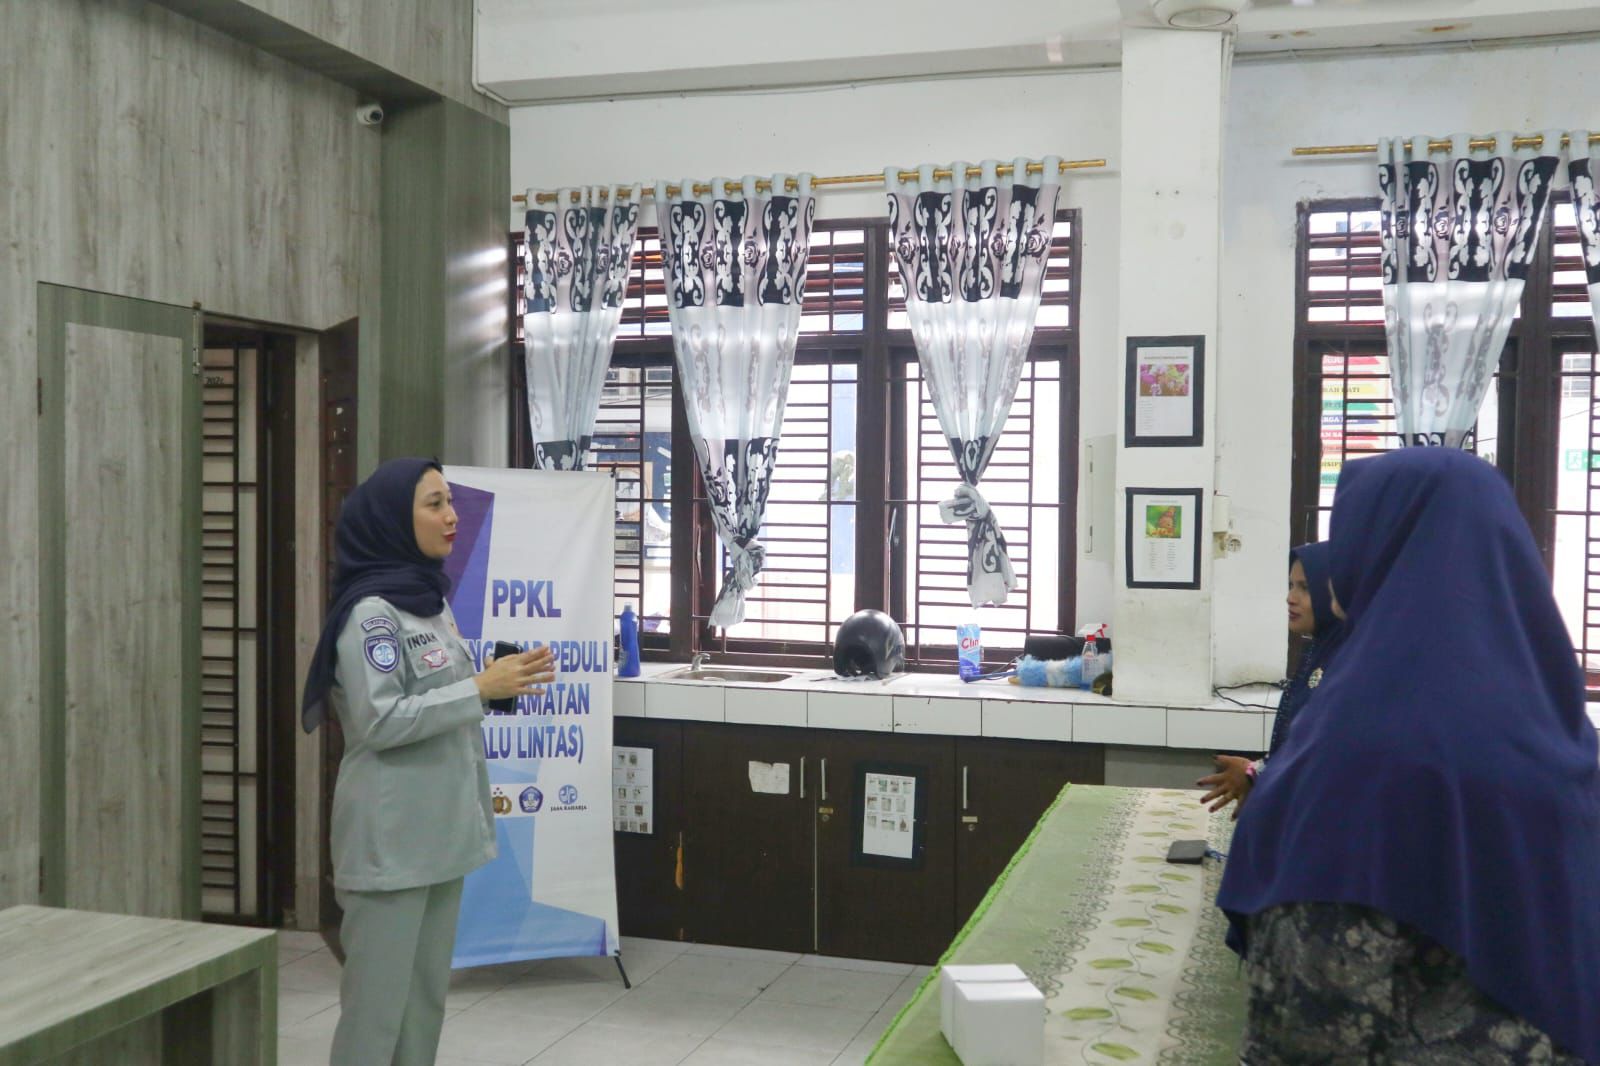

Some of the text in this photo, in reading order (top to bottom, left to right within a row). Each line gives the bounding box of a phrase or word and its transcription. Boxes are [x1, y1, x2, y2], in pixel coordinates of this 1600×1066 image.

[492, 579, 562, 618] PPKL
[550, 640, 608, 673] PEDULI
[517, 724, 584, 764] LINTAS)
